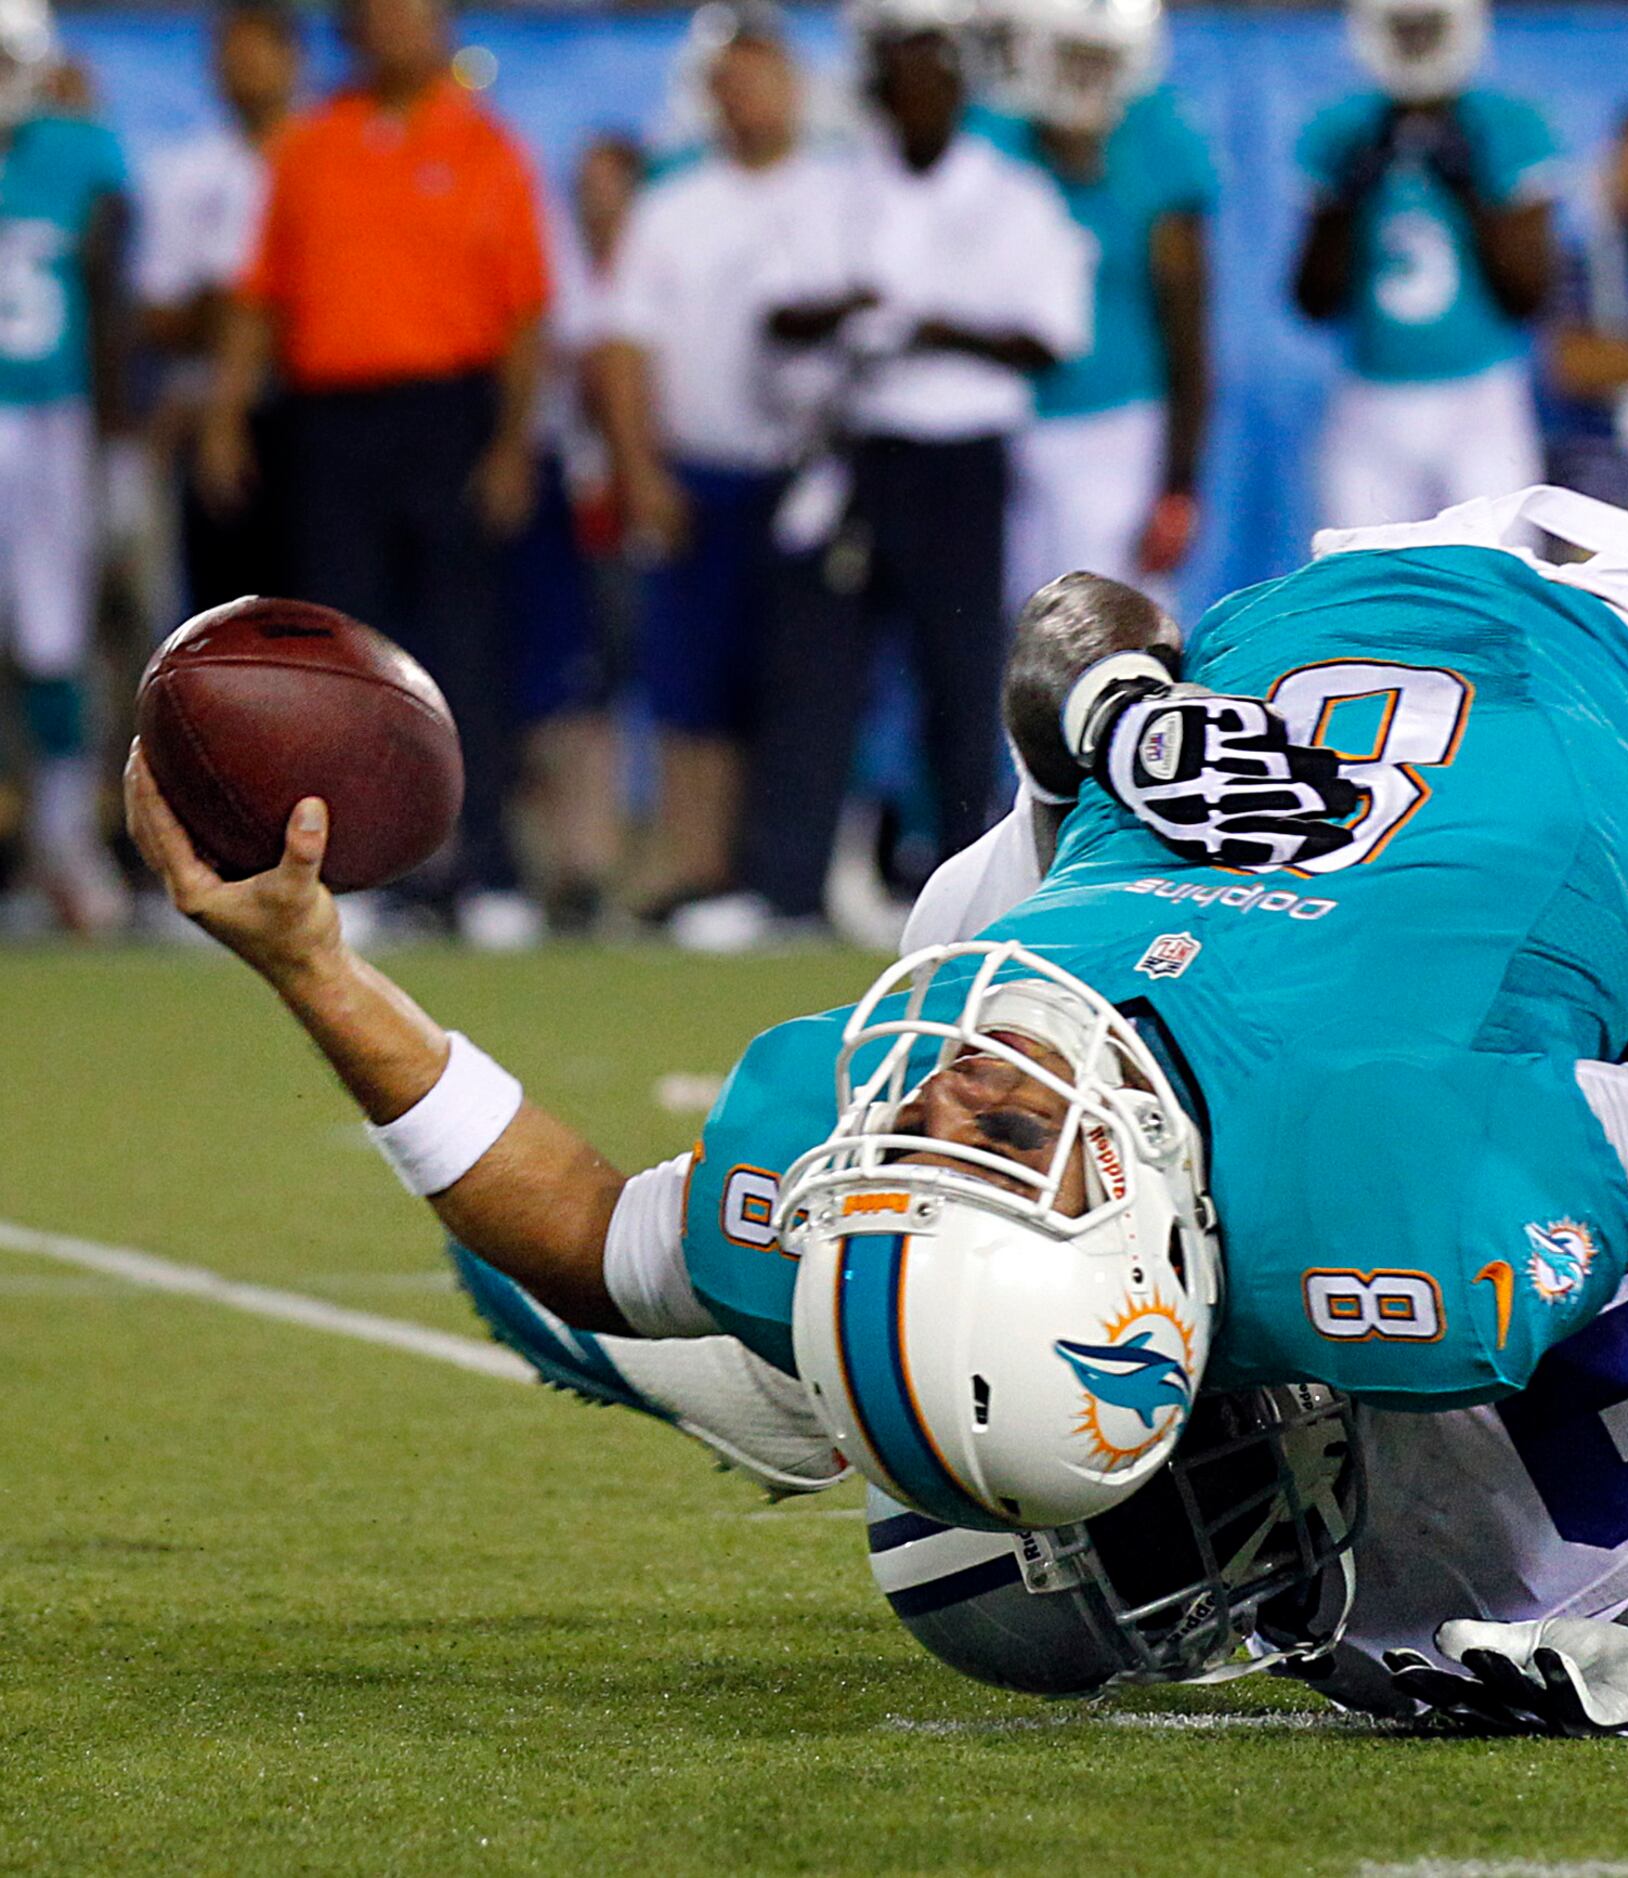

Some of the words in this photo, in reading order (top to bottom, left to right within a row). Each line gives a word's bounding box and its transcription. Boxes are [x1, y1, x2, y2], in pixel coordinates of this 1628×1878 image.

[1374, 207, 1462, 325] 3
[1124, 877, 1339, 921] Dolphins
[1301, 1266, 1448, 1343] 8
